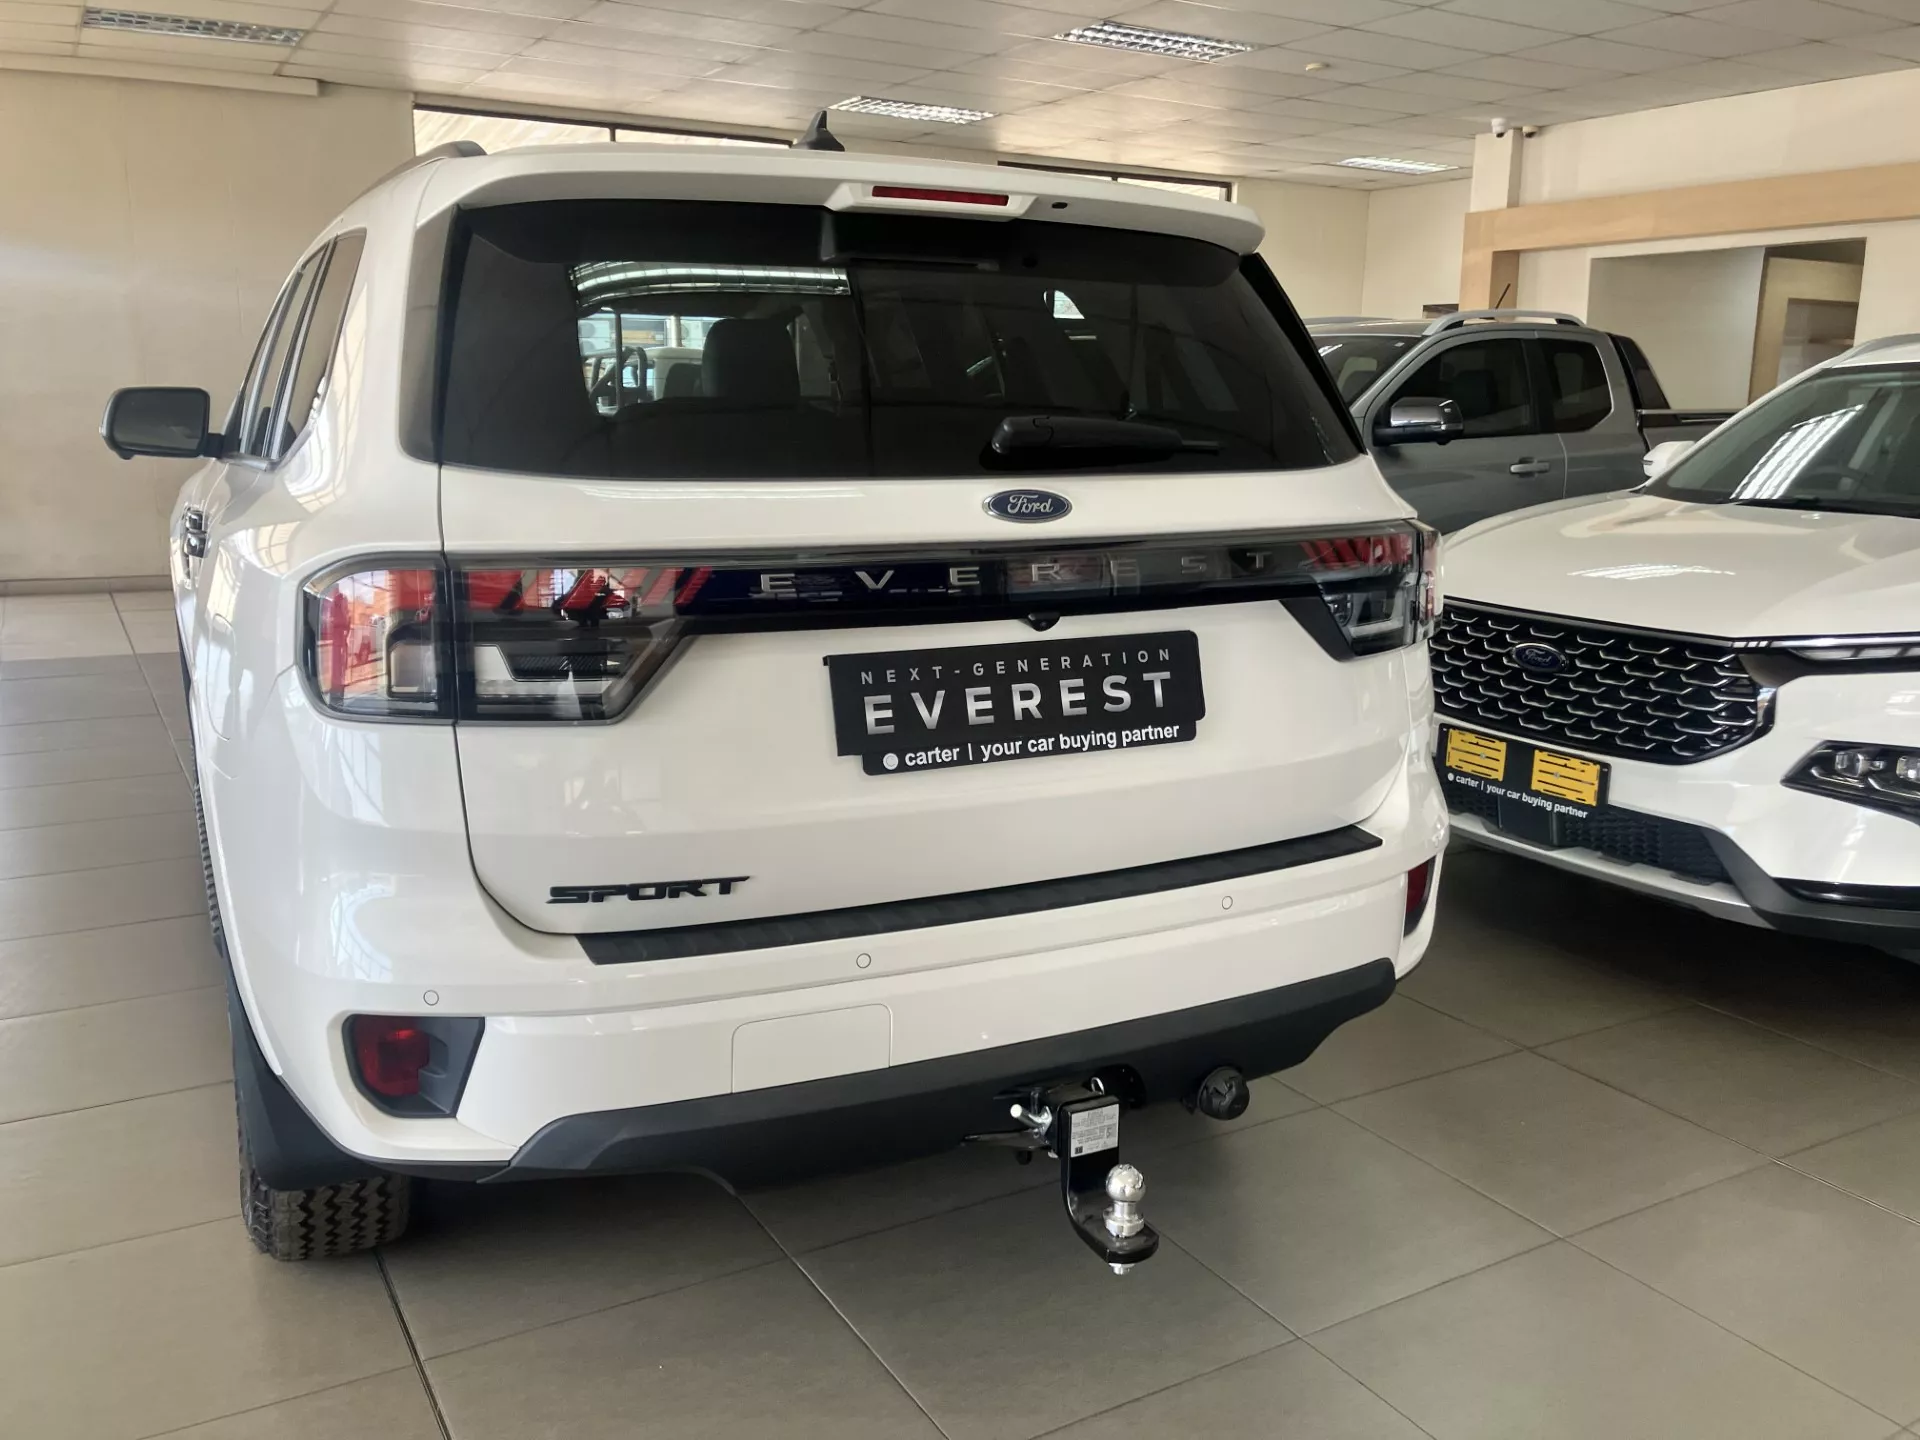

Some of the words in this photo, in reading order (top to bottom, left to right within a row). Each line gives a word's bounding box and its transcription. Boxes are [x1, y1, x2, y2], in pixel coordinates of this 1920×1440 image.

[1007, 494, 1053, 514] Ford
[760, 551, 1273, 594] EVEREST
[861, 648, 1171, 685] NEXT-GENERATION
[864, 671, 1172, 735] EVEREST
[904, 746, 960, 767] carter
[980, 740, 1022, 762] your
[1027, 736, 1055, 753] car
[1059, 730, 1117, 752] buying
[1121, 725, 1180, 747] partner
[1455, 774, 1479, 788] carter
[1486, 783, 1506, 795] your
[1506, 789, 1521, 800] car
[1521, 792, 1553, 812] buying
[1553, 803, 1588, 819] partner
[546, 875, 751, 904] SPORT
